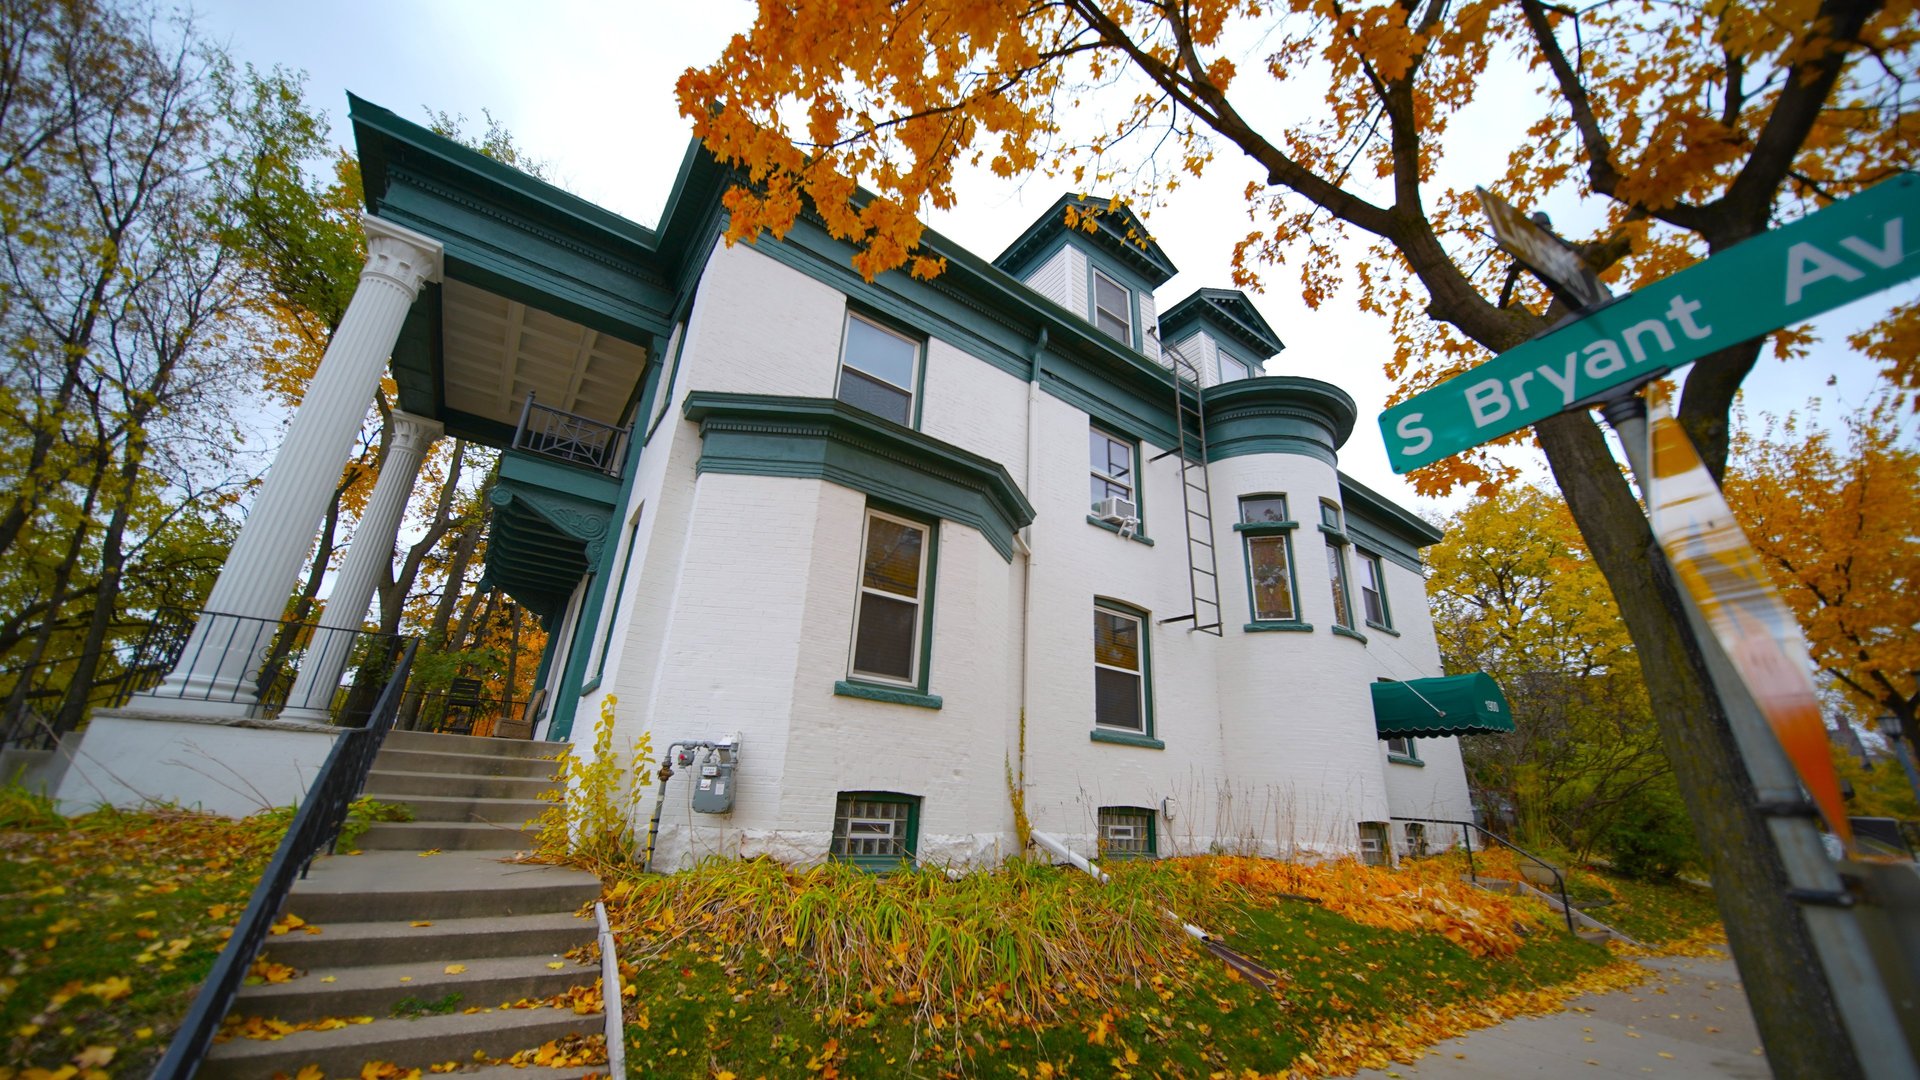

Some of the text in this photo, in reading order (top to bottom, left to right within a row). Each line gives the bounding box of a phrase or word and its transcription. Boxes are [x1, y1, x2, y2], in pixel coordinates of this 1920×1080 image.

[1396, 216, 1904, 456] S Bryant Av
